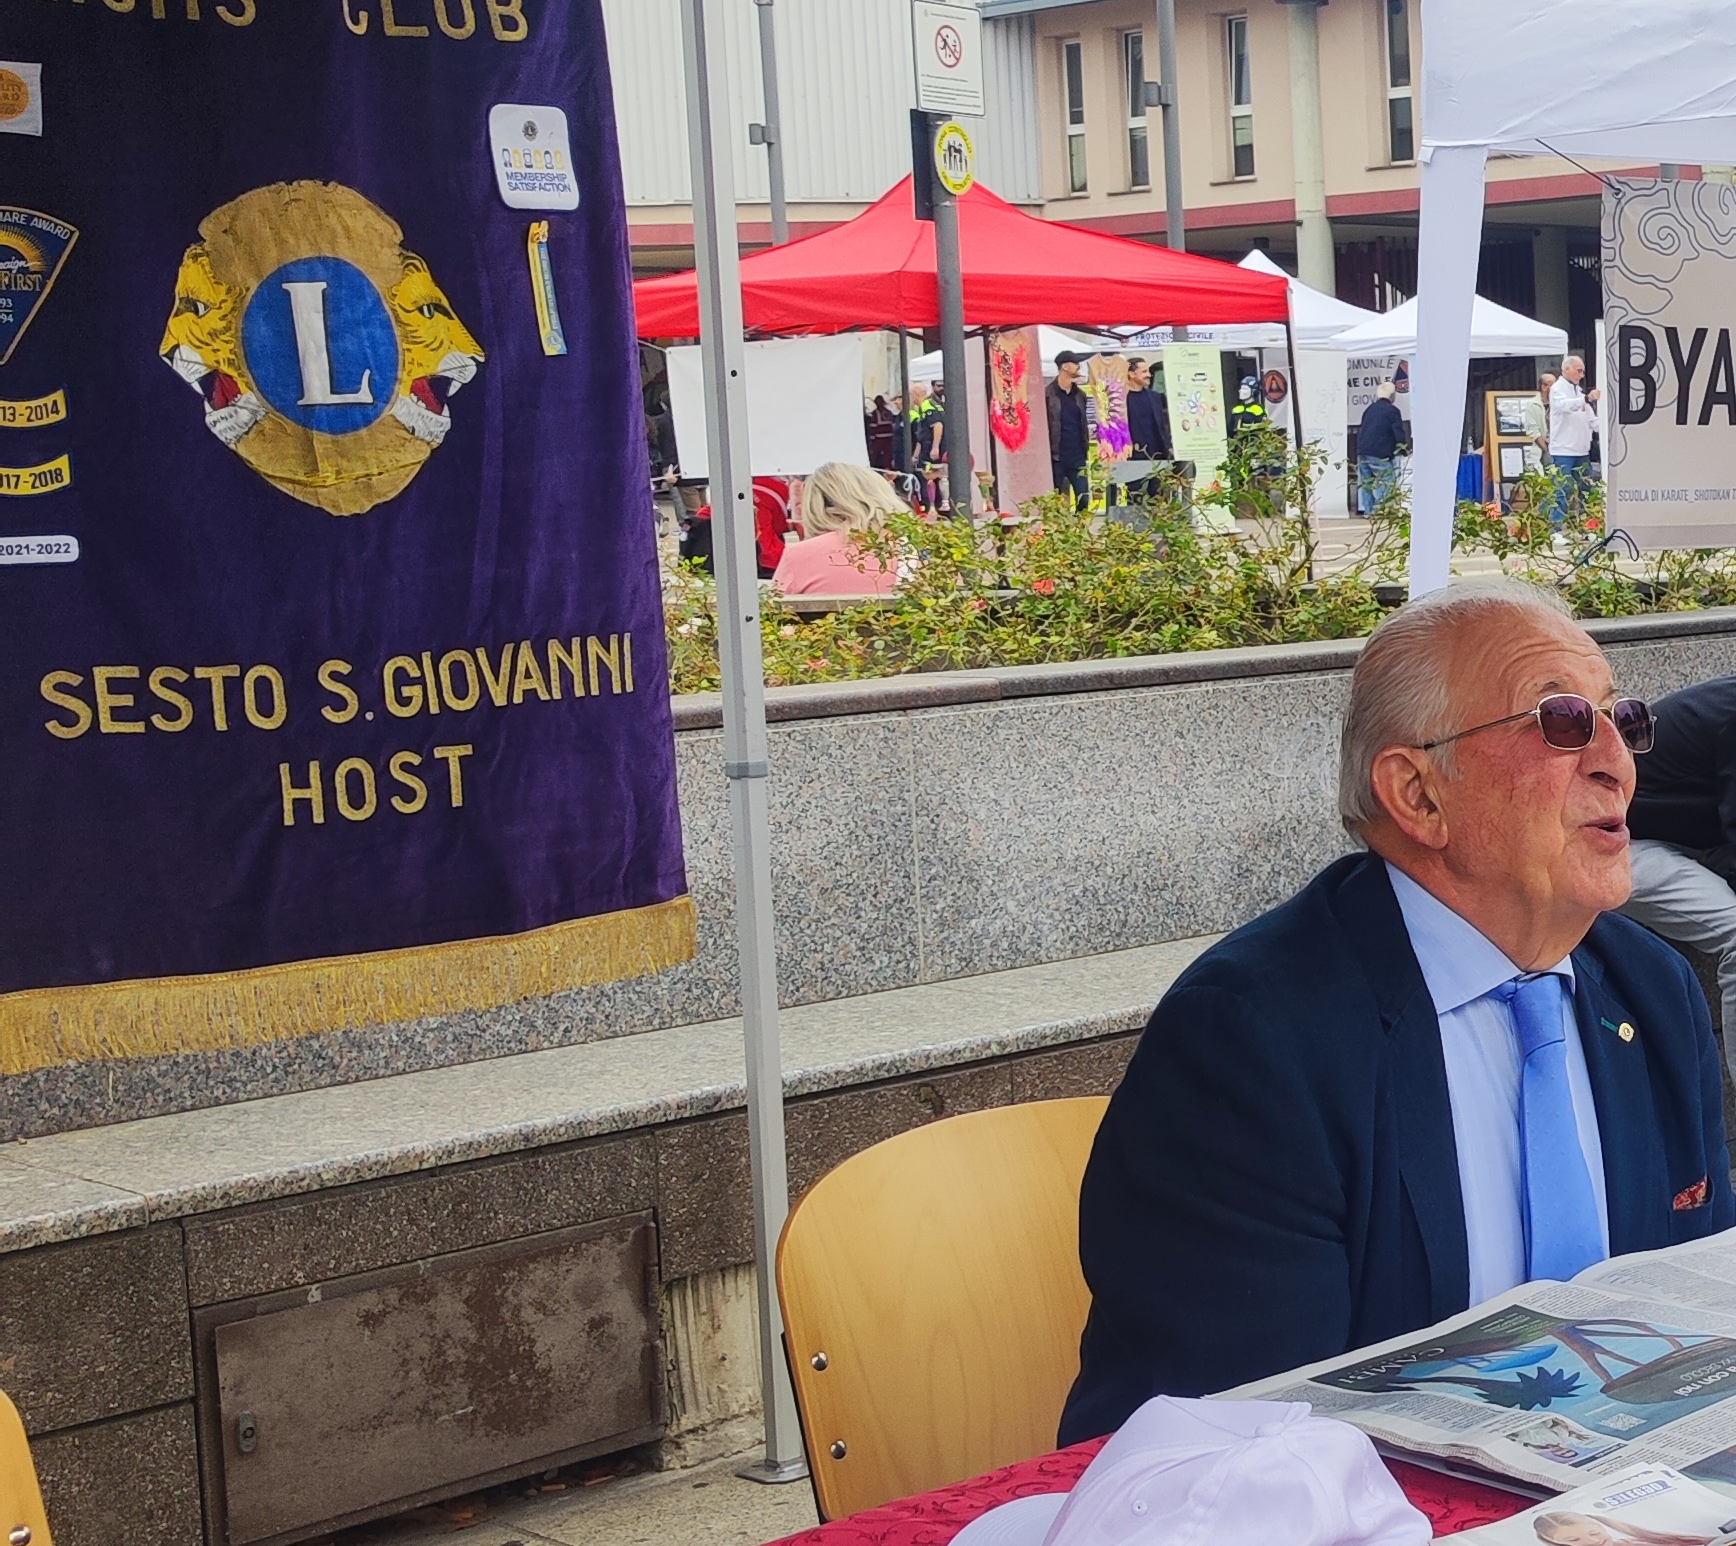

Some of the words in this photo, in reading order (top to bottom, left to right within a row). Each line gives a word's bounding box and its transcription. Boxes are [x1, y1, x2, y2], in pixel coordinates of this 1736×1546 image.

[505, 172, 567, 183] MEMBERSHIP
[508, 182, 572, 193] SATISFACTION
[30, 217, 71, 240] AWARD
[0, 273, 42, 291] FIRST
[281, 281, 374, 407] L
[1618, 489, 1649, 502] SCUOLA
[1651, 490, 1659, 501] DI
[39, 663, 288, 740] SESTO
[279, 744, 475, 827] HOST
